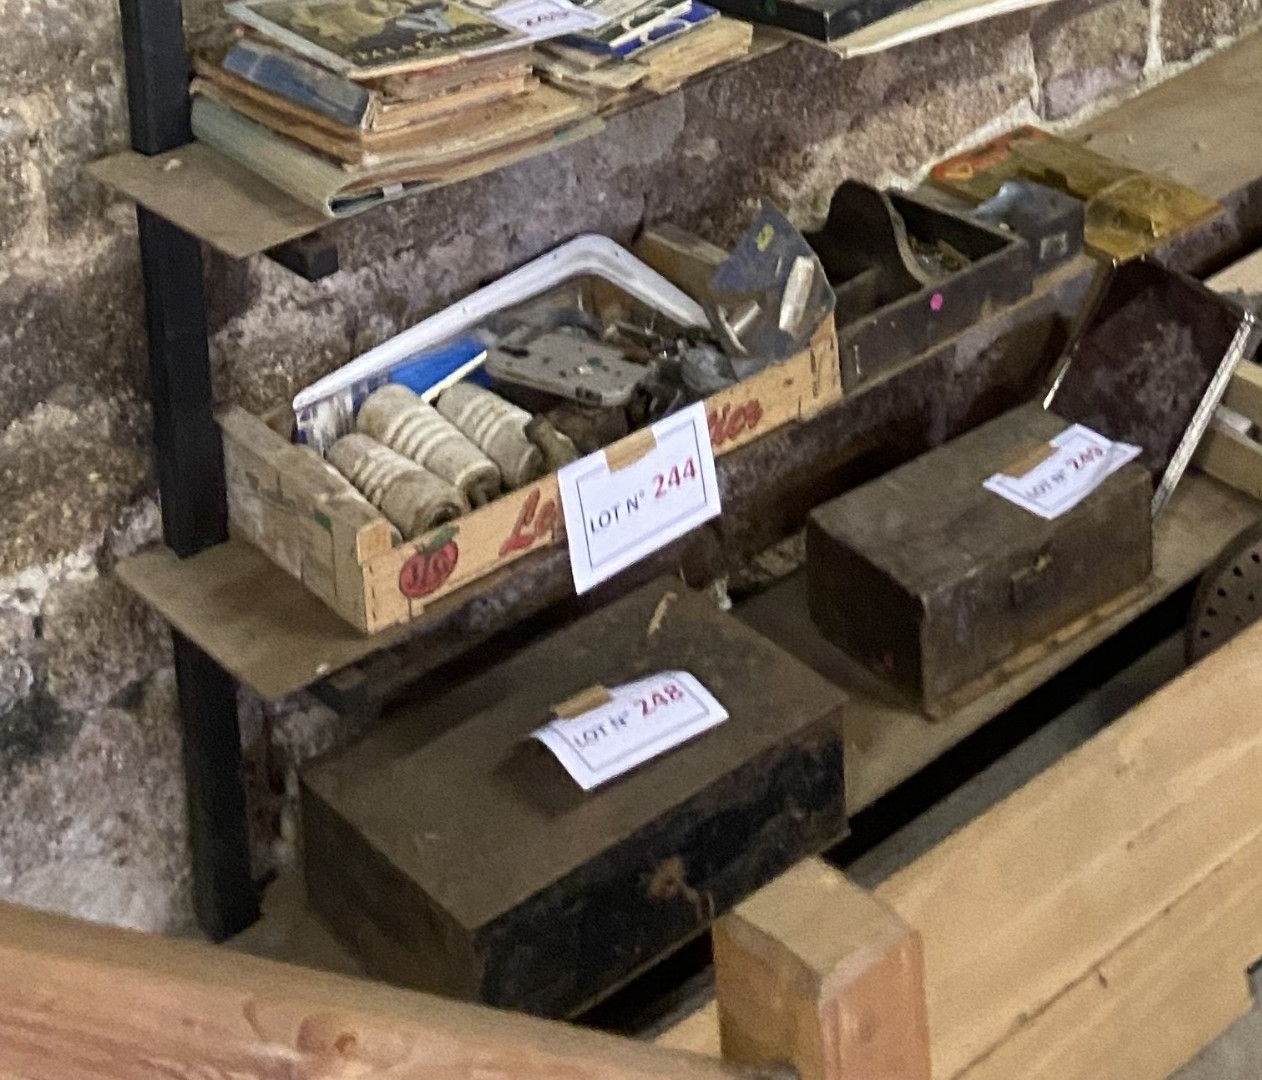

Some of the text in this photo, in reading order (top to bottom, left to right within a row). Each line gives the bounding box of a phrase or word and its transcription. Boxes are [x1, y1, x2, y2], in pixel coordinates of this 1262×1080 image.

[589, 455, 697, 535] LOT N° 244
[573, 723, 608, 748] LOT
[634, 683, 684, 717] 248
